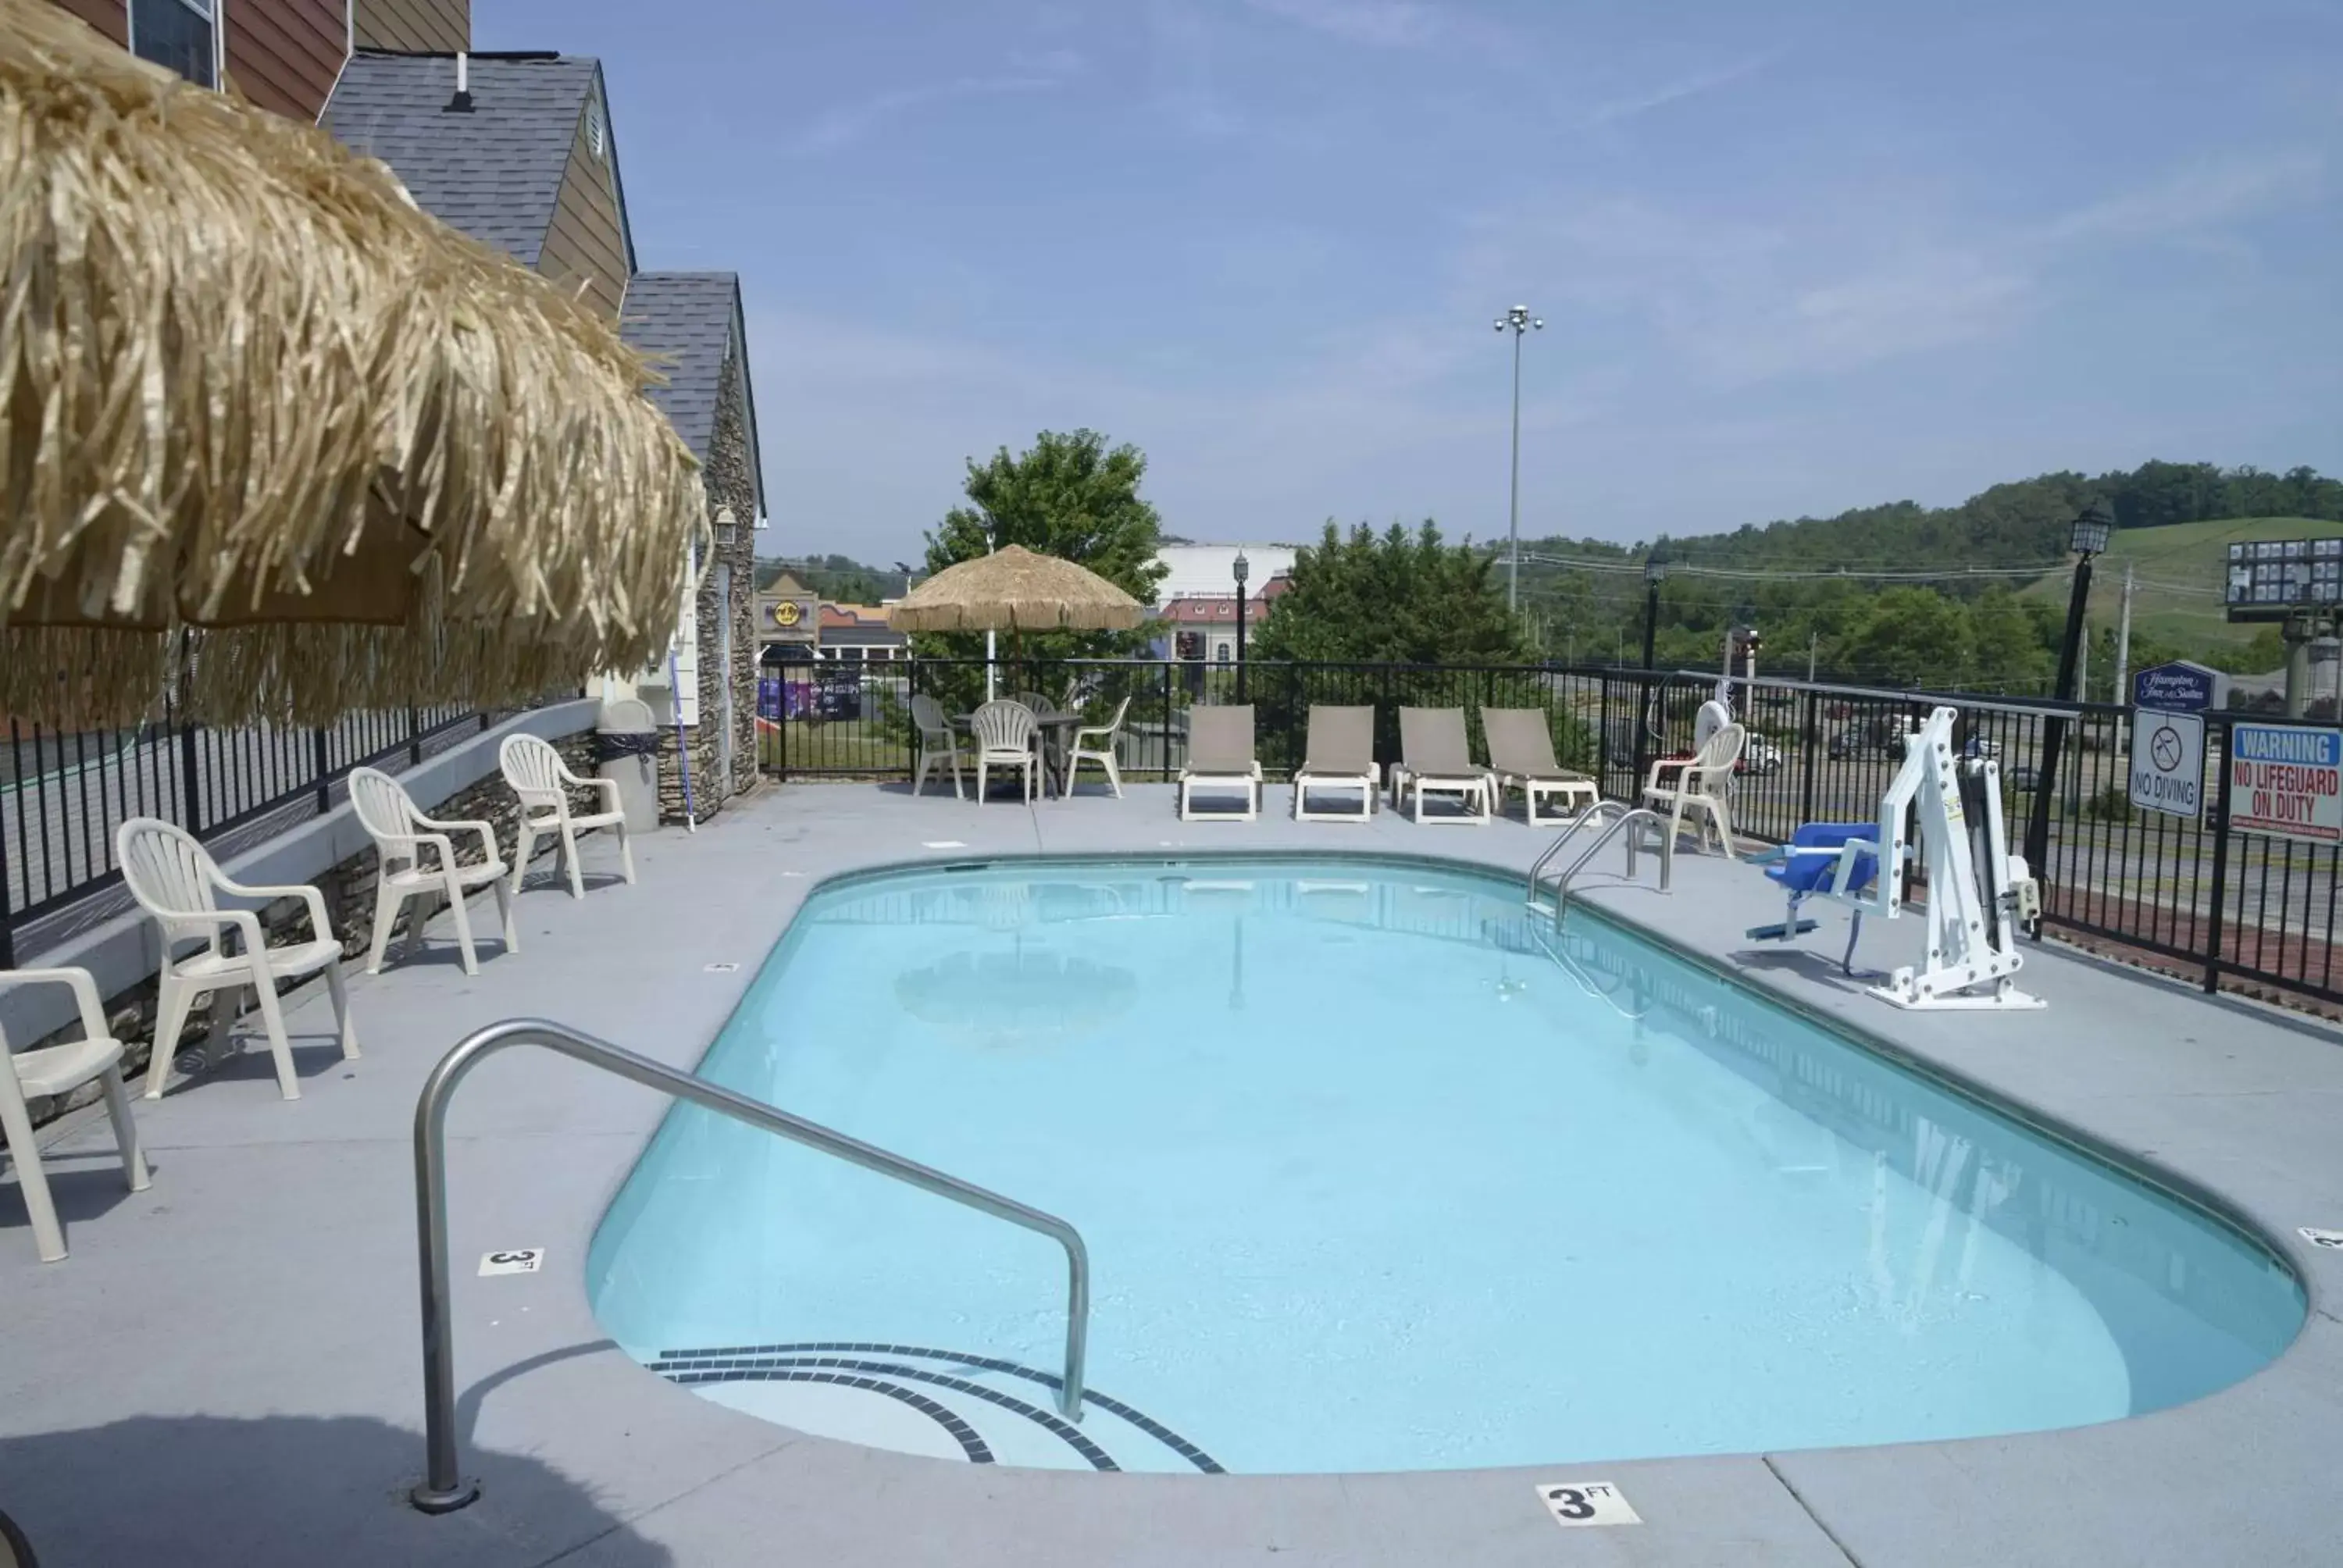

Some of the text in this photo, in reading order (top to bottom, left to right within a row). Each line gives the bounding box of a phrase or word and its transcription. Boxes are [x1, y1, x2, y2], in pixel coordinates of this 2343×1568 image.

[2143, 672, 2199, 687] Hampton
[2241, 730, 2330, 763] WARNING
[2135, 772, 2194, 806] NO DIVING
[2234, 761, 2338, 796] NO LIFEGUARD
[2252, 792, 2315, 822] ON DUTY
[490, 1251, 535, 1263] 3
[1549, 1486, 1612, 1519] 3 FT
